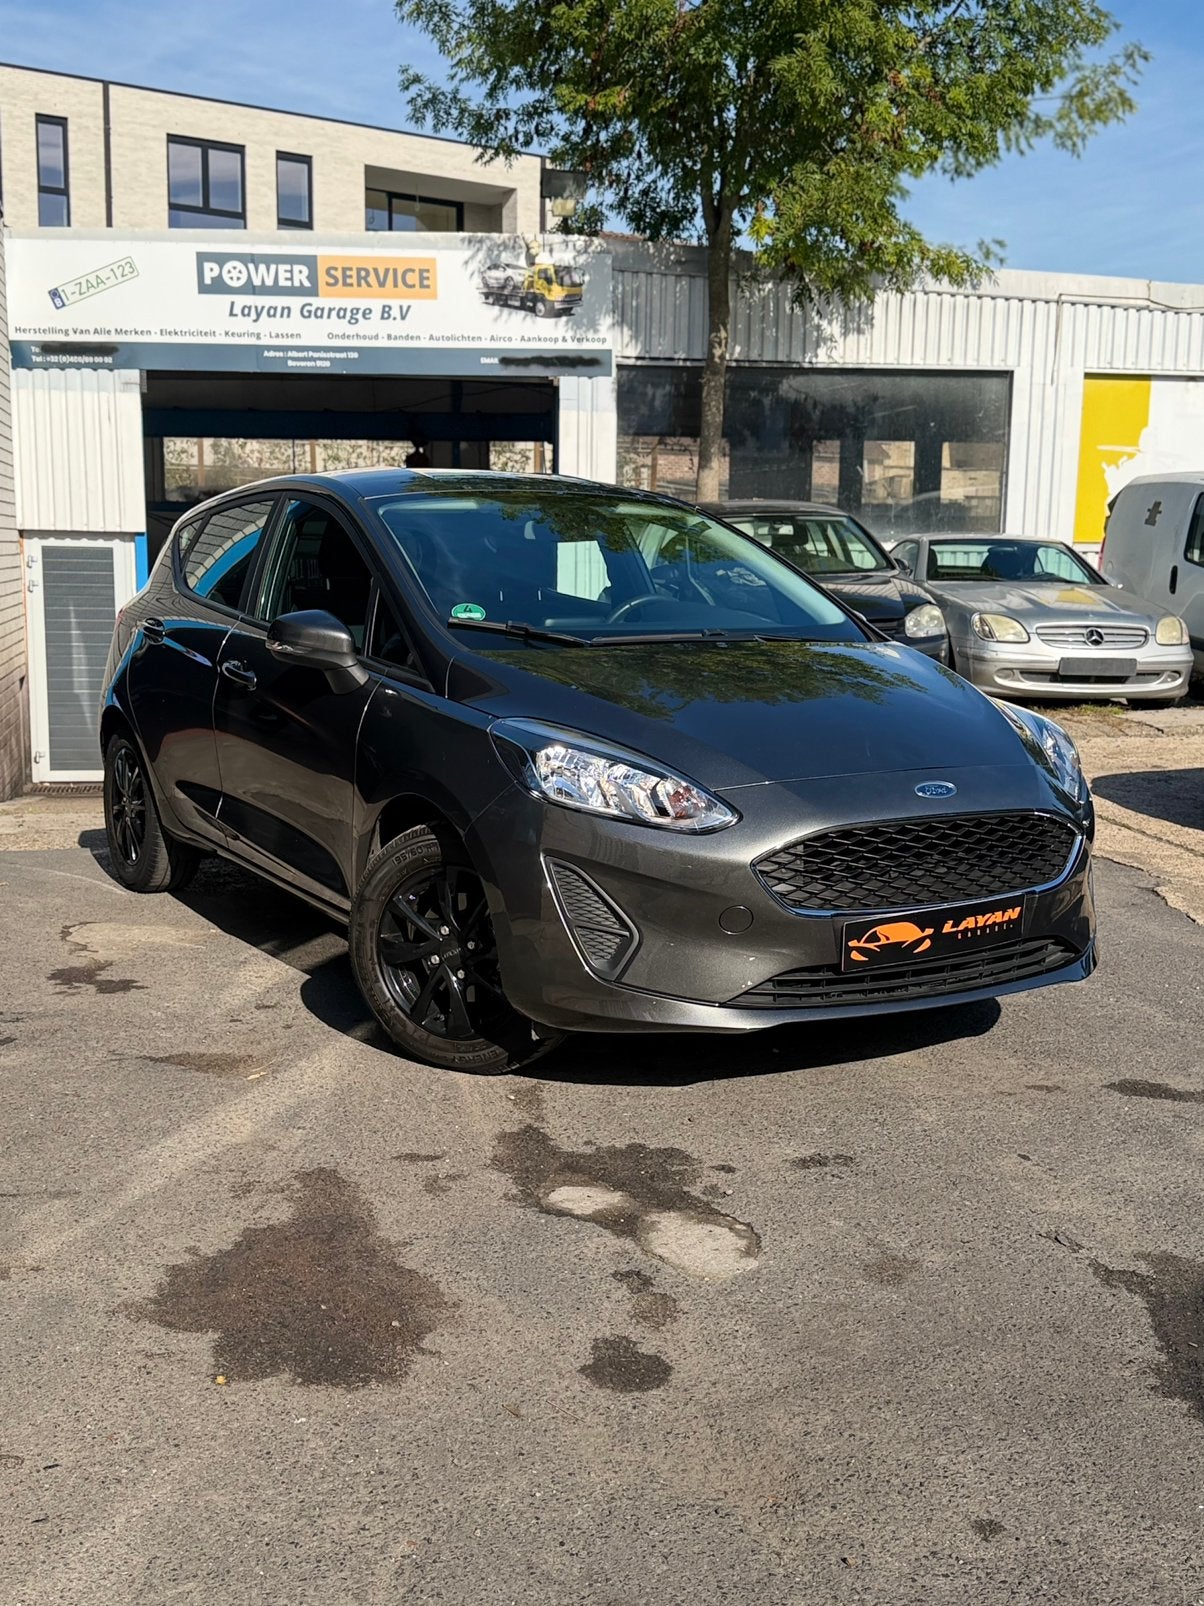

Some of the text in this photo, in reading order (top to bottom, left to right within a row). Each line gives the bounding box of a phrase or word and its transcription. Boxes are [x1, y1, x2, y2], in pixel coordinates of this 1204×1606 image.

[61, 260, 136, 302] 1-ZAA-123
[203, 260, 431, 289] POWER SERVICE
[229, 301, 412, 325] Layan Garage B.V
[14, 326, 70, 336] Herstelling
[72, 327, 91, 336] Van
[93, 327, 112, 336] Alle
[114, 328, 152, 336] Merken
[160, 328, 217, 337] Elektriciteit
[224, 330, 262, 340] Keuring
[269, 331, 302, 339] Lassen
[327, 332, 379, 341] Onderhoud
[387, 333, 421, 341] Banden
[428, 334, 482, 342] Autolichten
[520, 335, 559, 344] Aankoop
[562, 335, 568, 343] &
[570, 335, 607, 344] Verkoop
[463, 605, 473, 613] 4
[942, 906, 1022, 933] LAYAN
